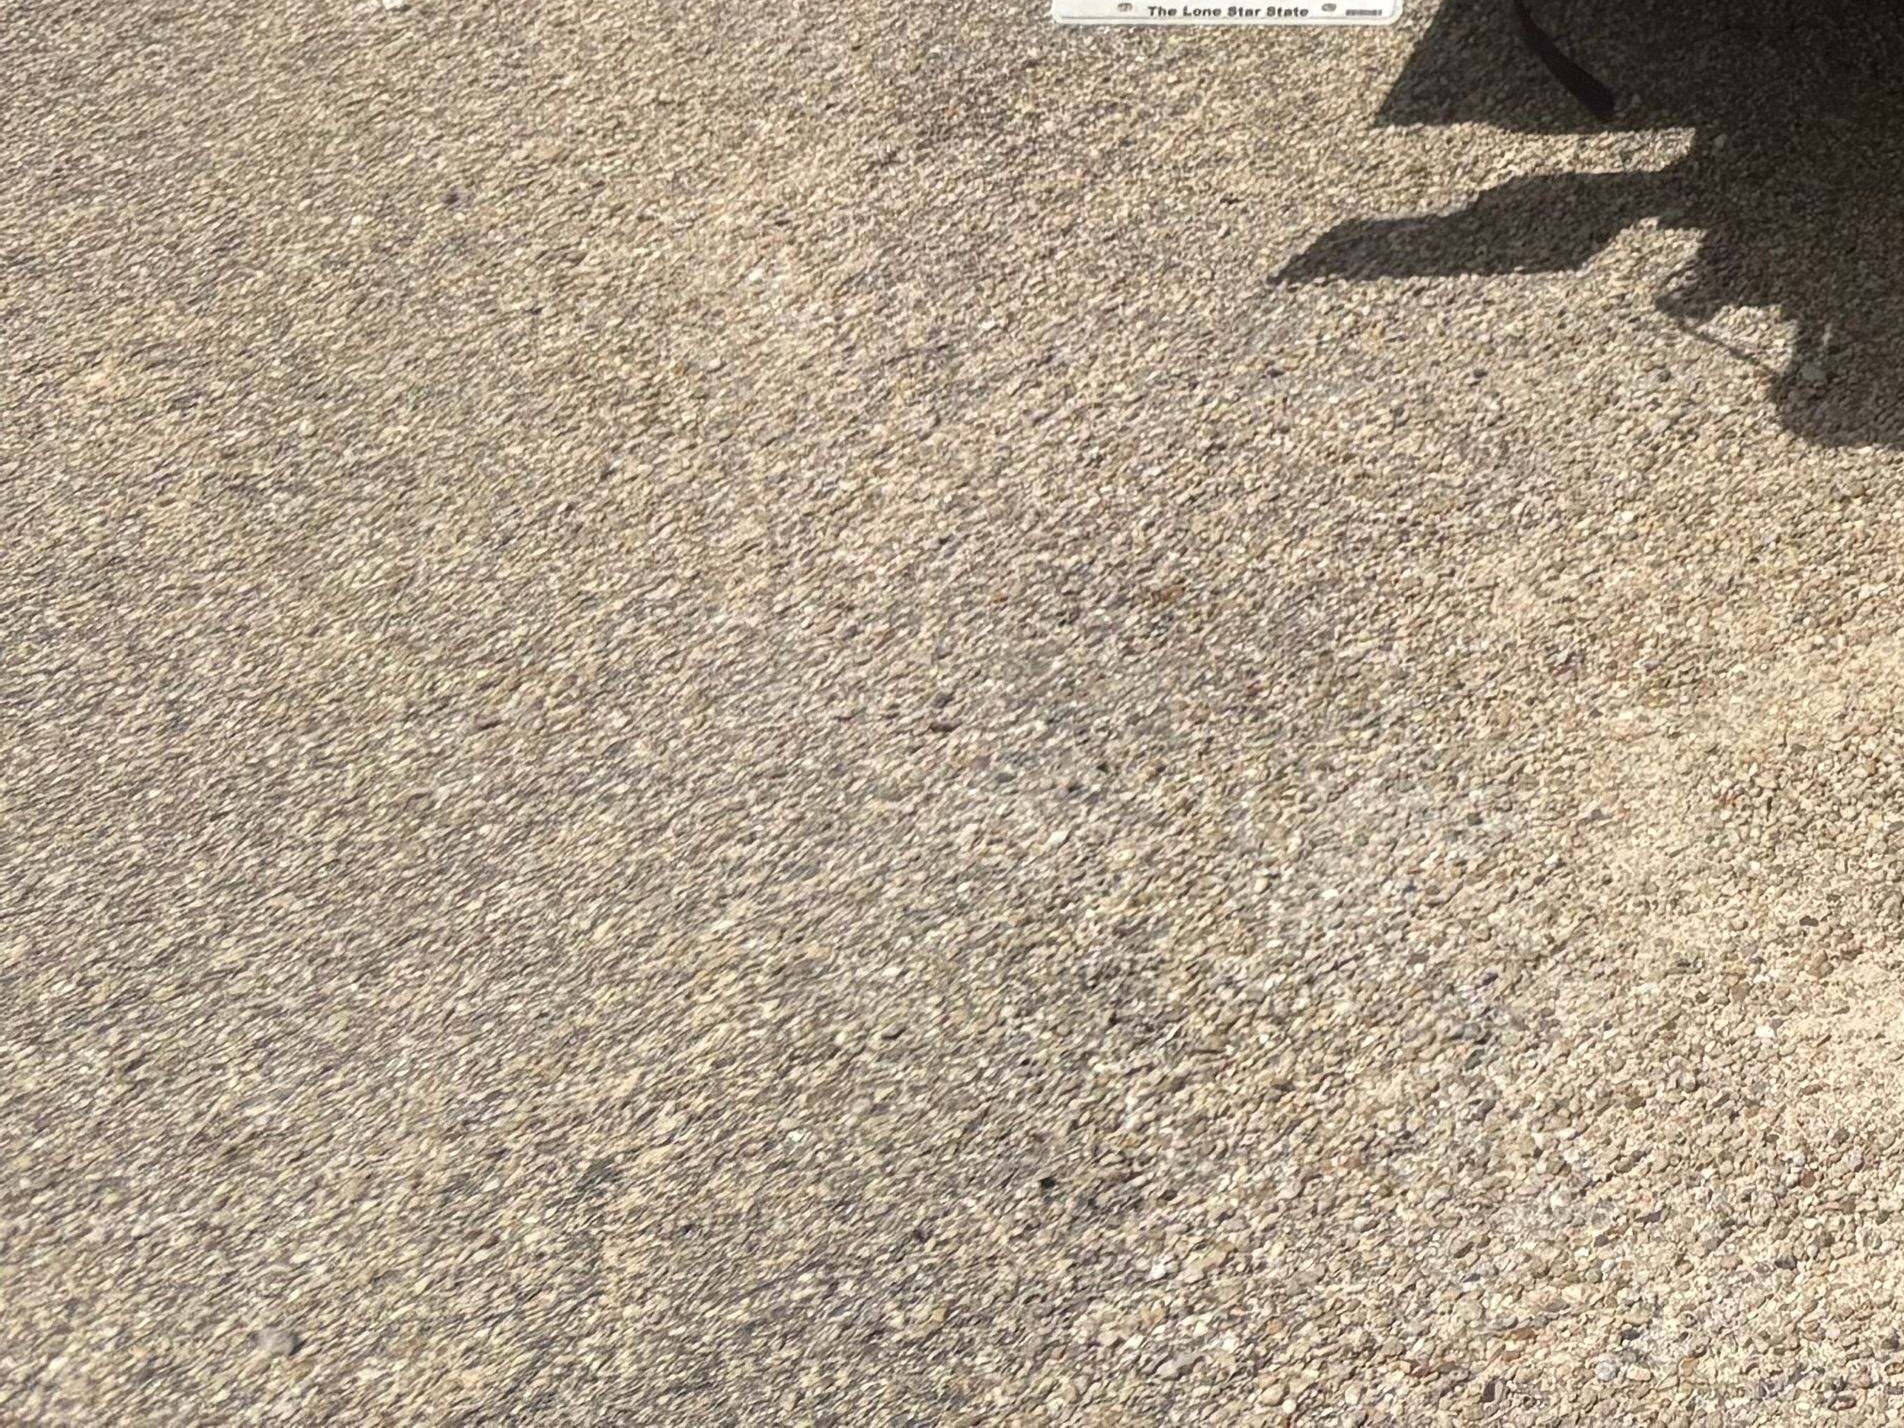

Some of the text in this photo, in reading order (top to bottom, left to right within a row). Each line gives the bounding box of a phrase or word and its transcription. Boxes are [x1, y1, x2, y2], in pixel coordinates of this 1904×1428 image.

[1147, 6, 1309, 17] The Lone Star State
